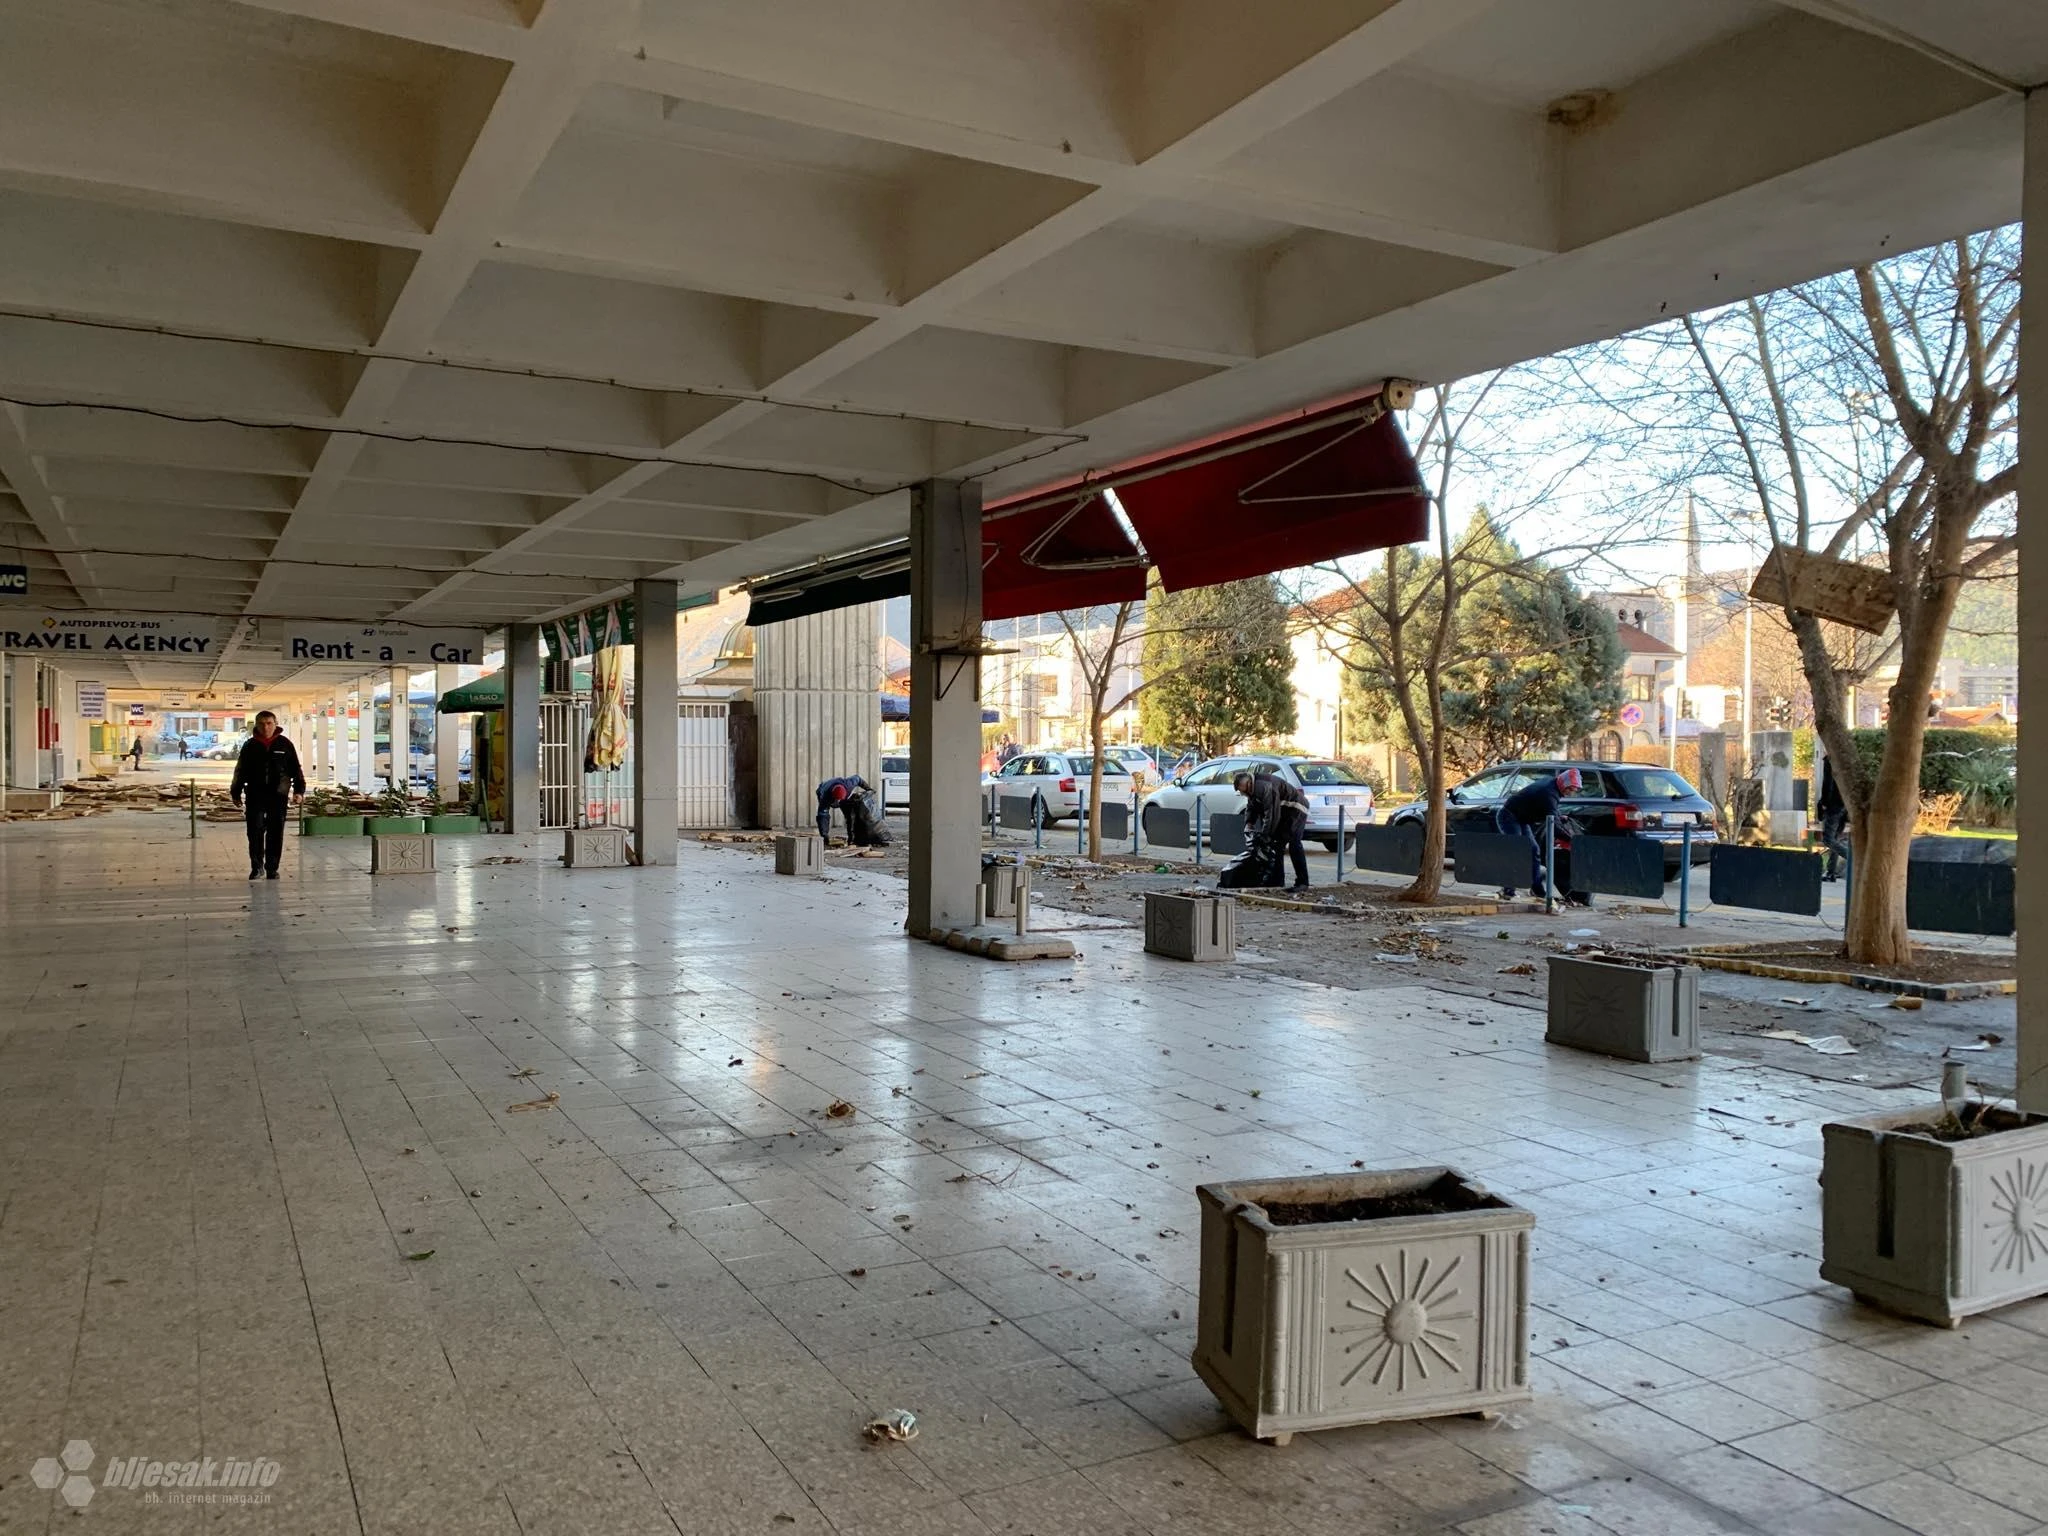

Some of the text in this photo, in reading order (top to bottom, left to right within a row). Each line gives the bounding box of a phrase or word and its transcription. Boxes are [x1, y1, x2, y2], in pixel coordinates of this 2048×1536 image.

[59, 620, 160, 629] AUTOPREVOZ-BUS
[0, 631, 210, 653] RAVEL AGENCY
[292, 638, 354, 660] Rent
[379, 645, 393, 661] a
[430, 642, 473, 663] Car
[396, 693, 403, 704] 1
[363, 701, 370, 710] 2
[338, 706, 345, 715] 3
[304, 713, 310, 721] 5
